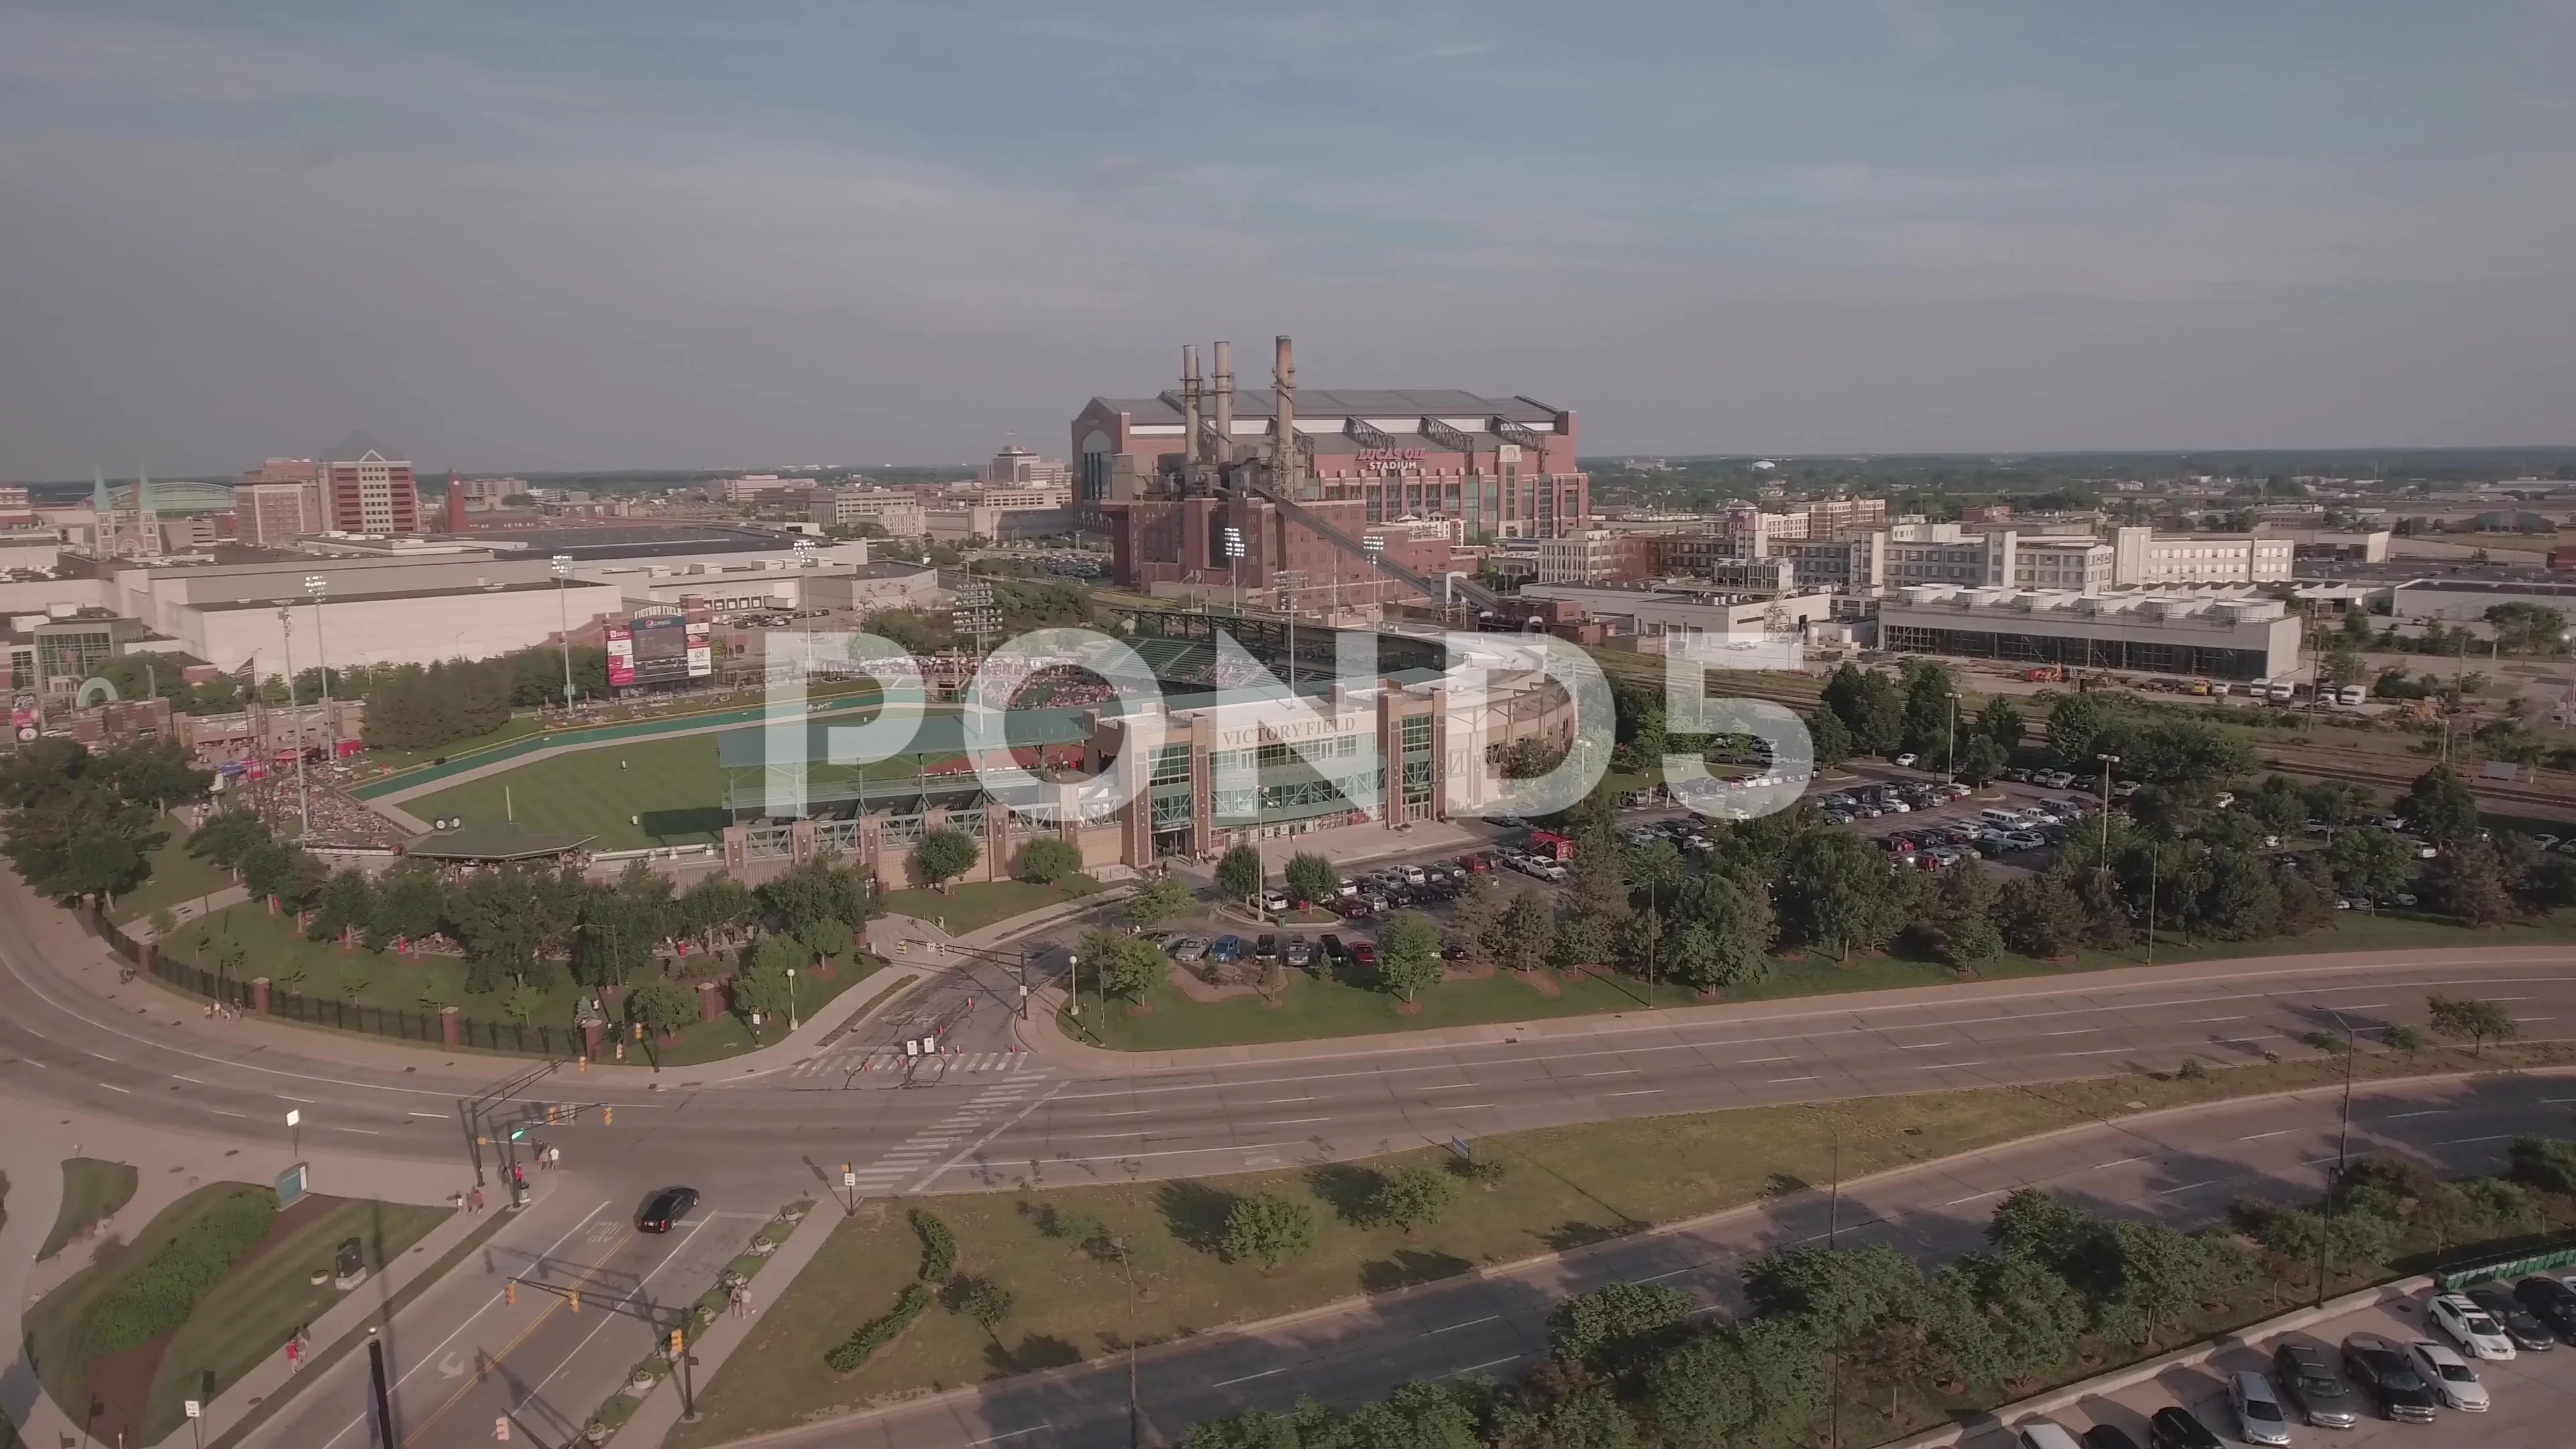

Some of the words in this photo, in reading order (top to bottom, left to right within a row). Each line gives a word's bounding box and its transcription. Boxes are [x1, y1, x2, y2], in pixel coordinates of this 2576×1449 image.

[1356, 447, 1402, 460] LUCAS
[1404, 447, 1426, 460] OIL
[1369, 461, 1417, 470] STADIUM
[633, 605, 661, 620] VICTORY
[662, 605, 682, 616] FIELD
[1222, 722, 1302, 746] VICTORY
[1306, 716, 1356, 736] FIELD
